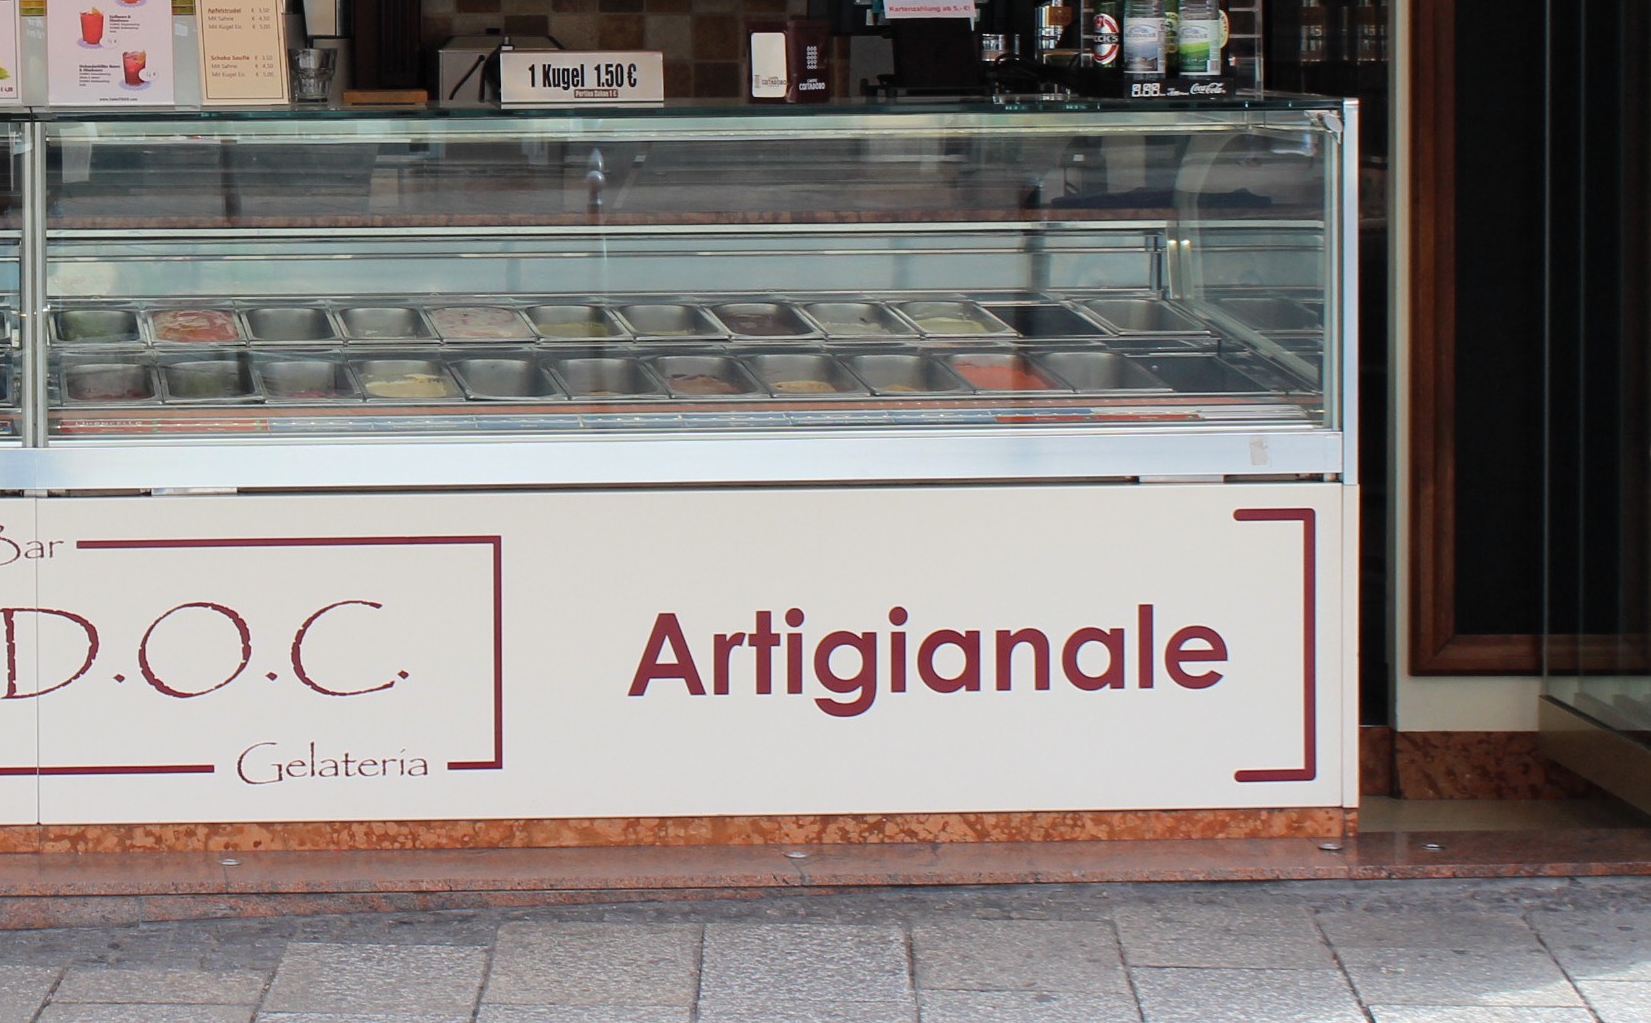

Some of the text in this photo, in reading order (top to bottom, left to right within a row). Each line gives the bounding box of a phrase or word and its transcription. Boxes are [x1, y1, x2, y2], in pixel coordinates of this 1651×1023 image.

[889, 5, 941, 14] Kartenzahlung
[528, 63, 637, 91] 1 Kugel 1.50 €
[628, 604, 1229, 718] Artigianale
[235, 740, 430, 786] Gelateria
